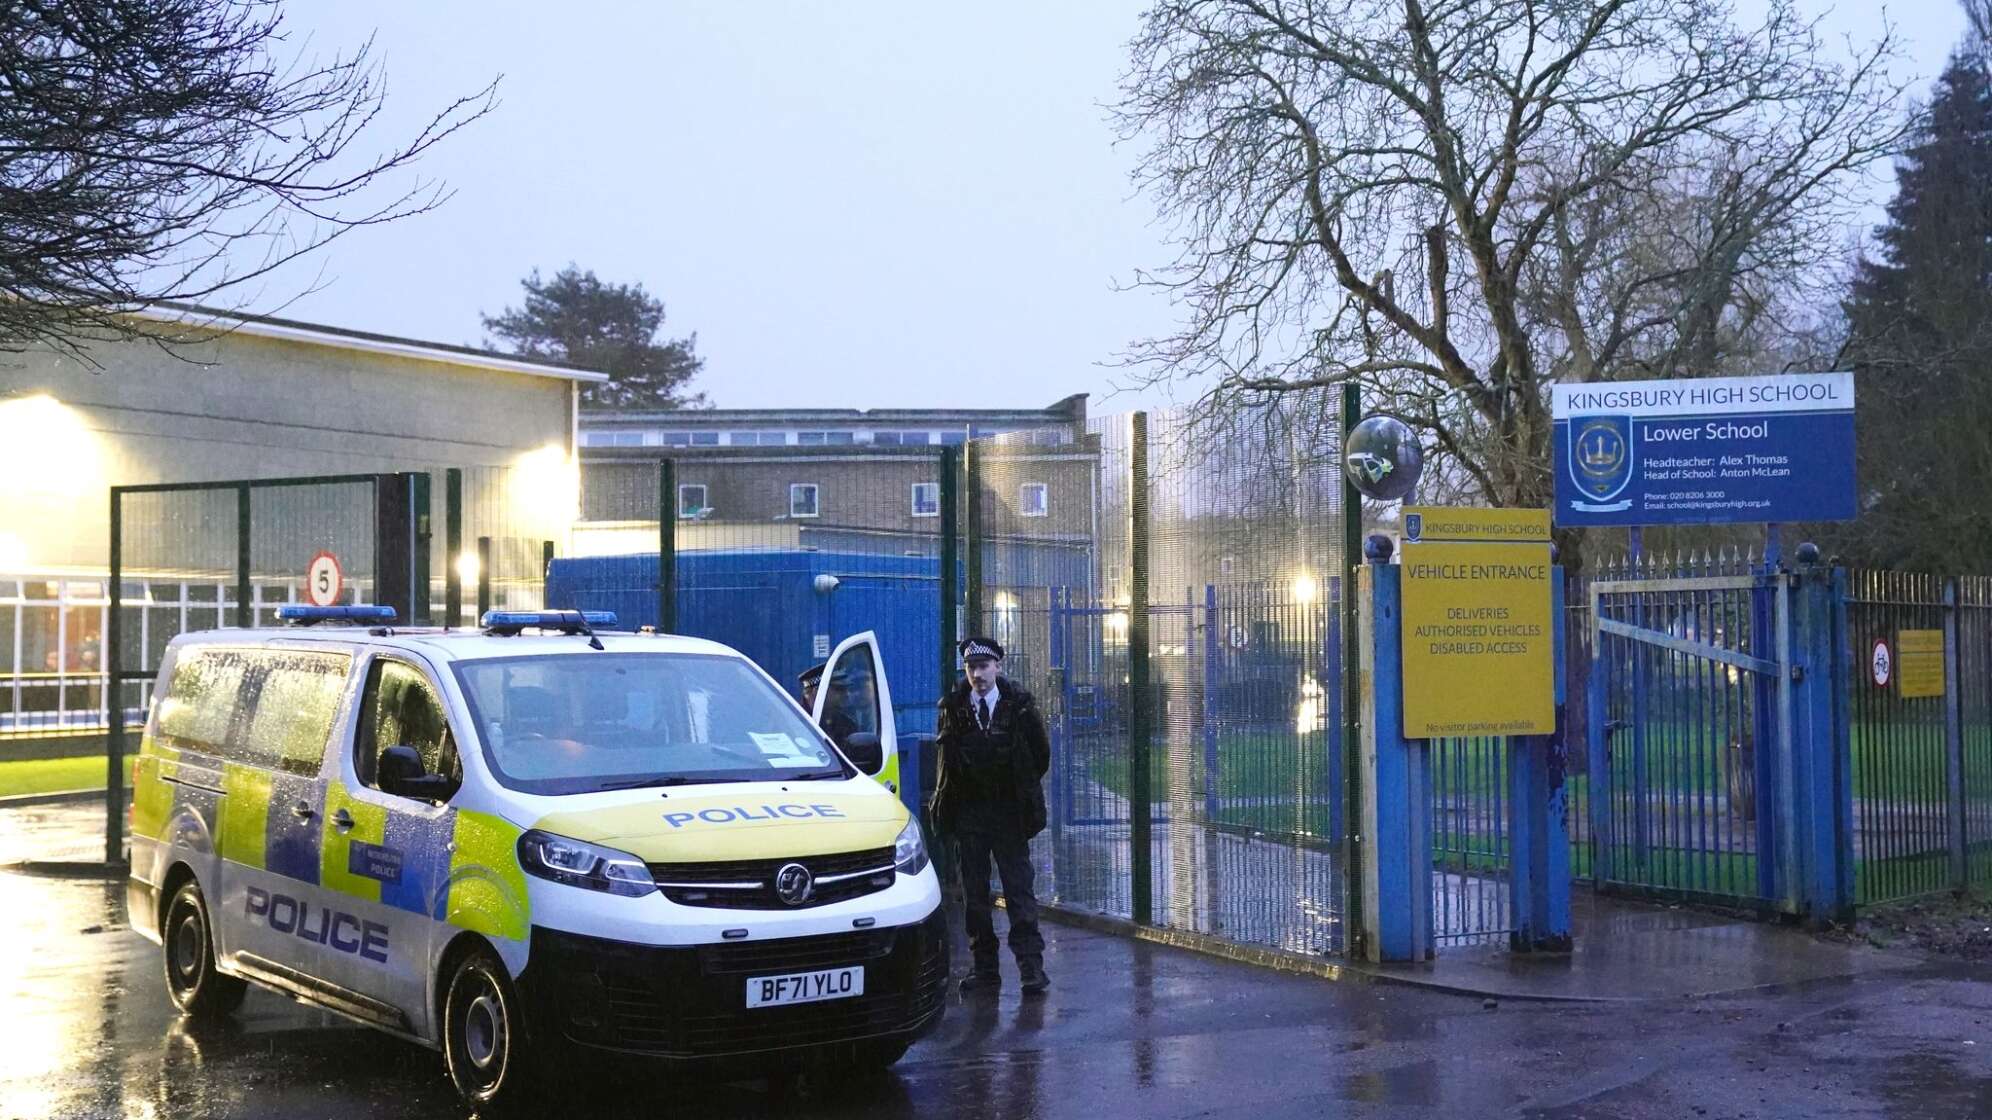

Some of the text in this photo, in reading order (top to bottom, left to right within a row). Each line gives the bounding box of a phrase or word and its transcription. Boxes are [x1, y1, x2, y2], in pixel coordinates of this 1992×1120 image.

[1568, 383, 1839, 410] KINGSBURY HIGH SCHOOL
[1643, 420, 1768, 442] Lower School
[1643, 454, 1788, 468] Headteacher: Alex Thomas
[1644, 467, 1790, 480] Head of School: Anton McLean
[1670, 491, 1684, 499] 020
[1644, 502, 1666, 510] Email:
[1425, 523, 1547, 535] KINGSBURY HIGH SCHOOL
[1407, 564, 1546, 580] VEHICLE ENTRANCE
[319, 570, 329, 594] 5
[1447, 607, 1509, 620] DELIVERIES
[1415, 624, 1541, 637] AUTHORISED VEHICLES
[1430, 642, 1527, 654] DISABLED ACCESS
[1426, 723, 1440, 732] No
[1467, 722, 1498, 732] parking
[663, 804, 847, 828] POLICE
[245, 886, 389, 963] POLICE
[761, 971, 852, 1002] BF71 YLO
